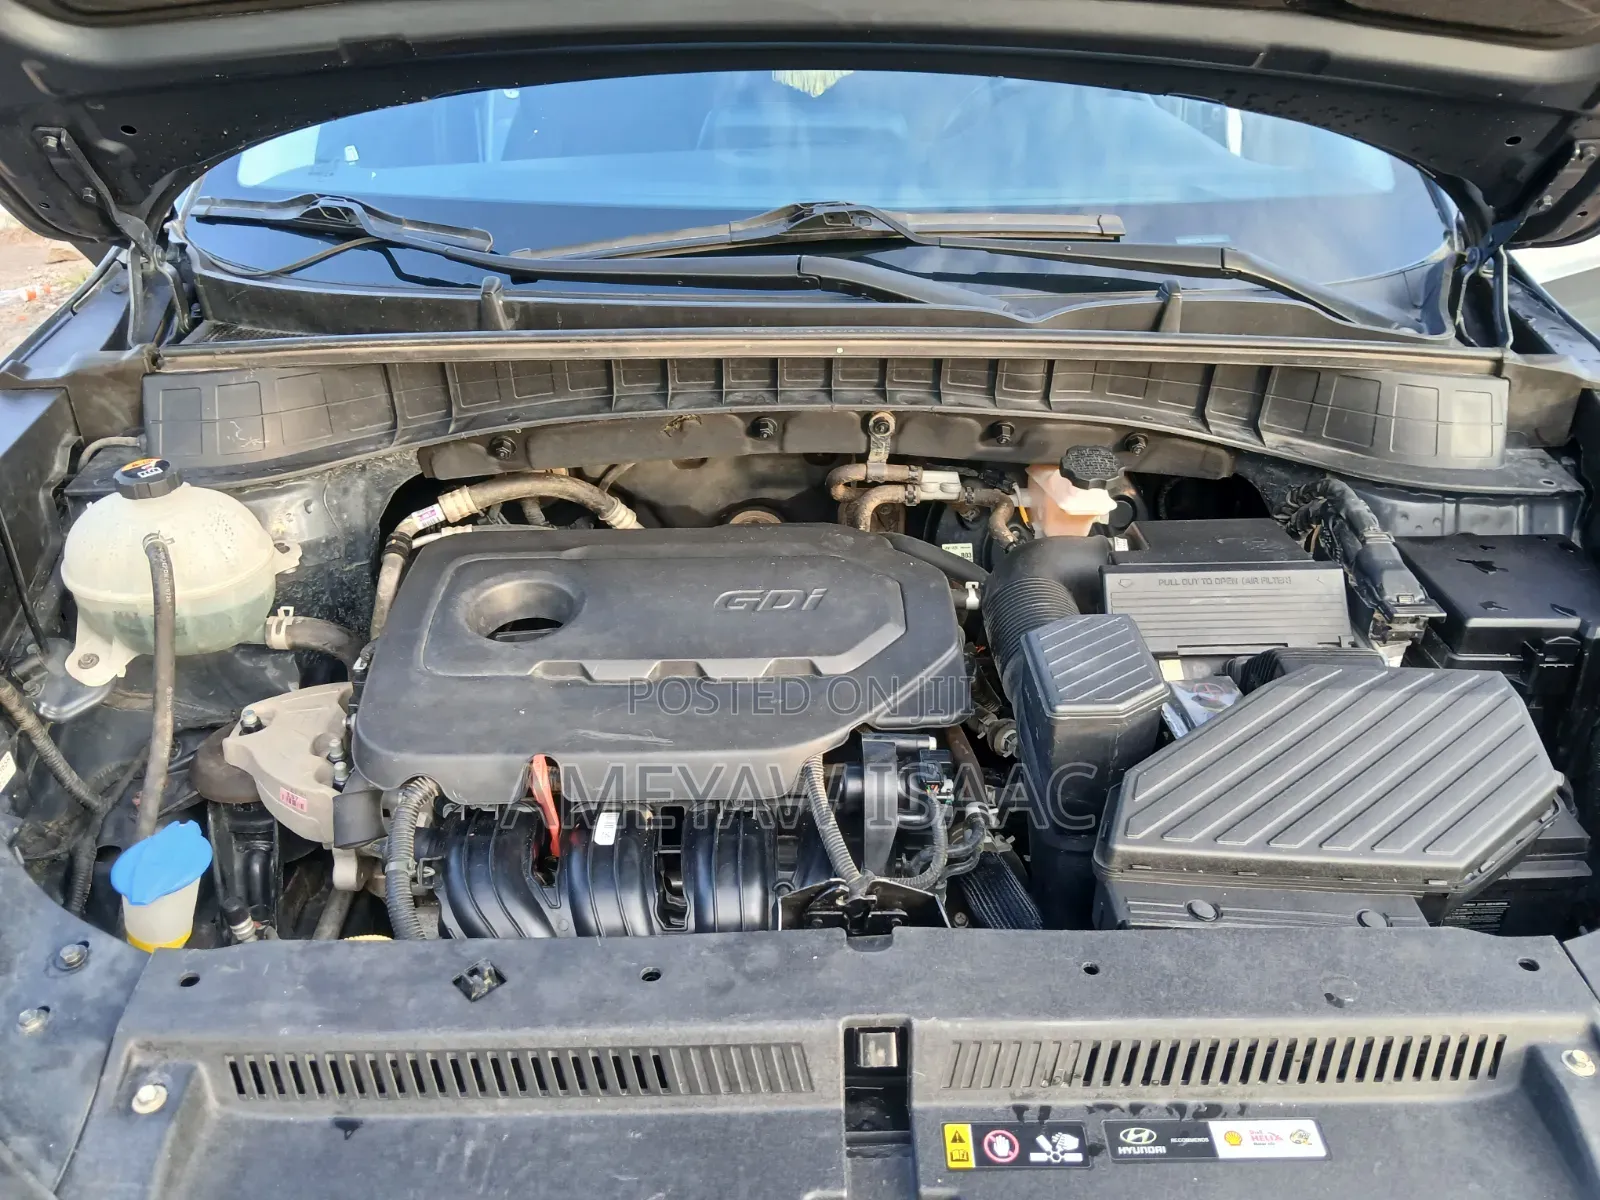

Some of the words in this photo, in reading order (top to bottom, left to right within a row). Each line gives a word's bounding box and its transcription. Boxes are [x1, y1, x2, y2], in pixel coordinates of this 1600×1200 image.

[1158, 578, 1180, 586] PULL
[1201, 577, 1213, 585] TO
[1215, 577, 1238, 585] OPEN
[1118, 1146, 1167, 1154] HYUNDAI
